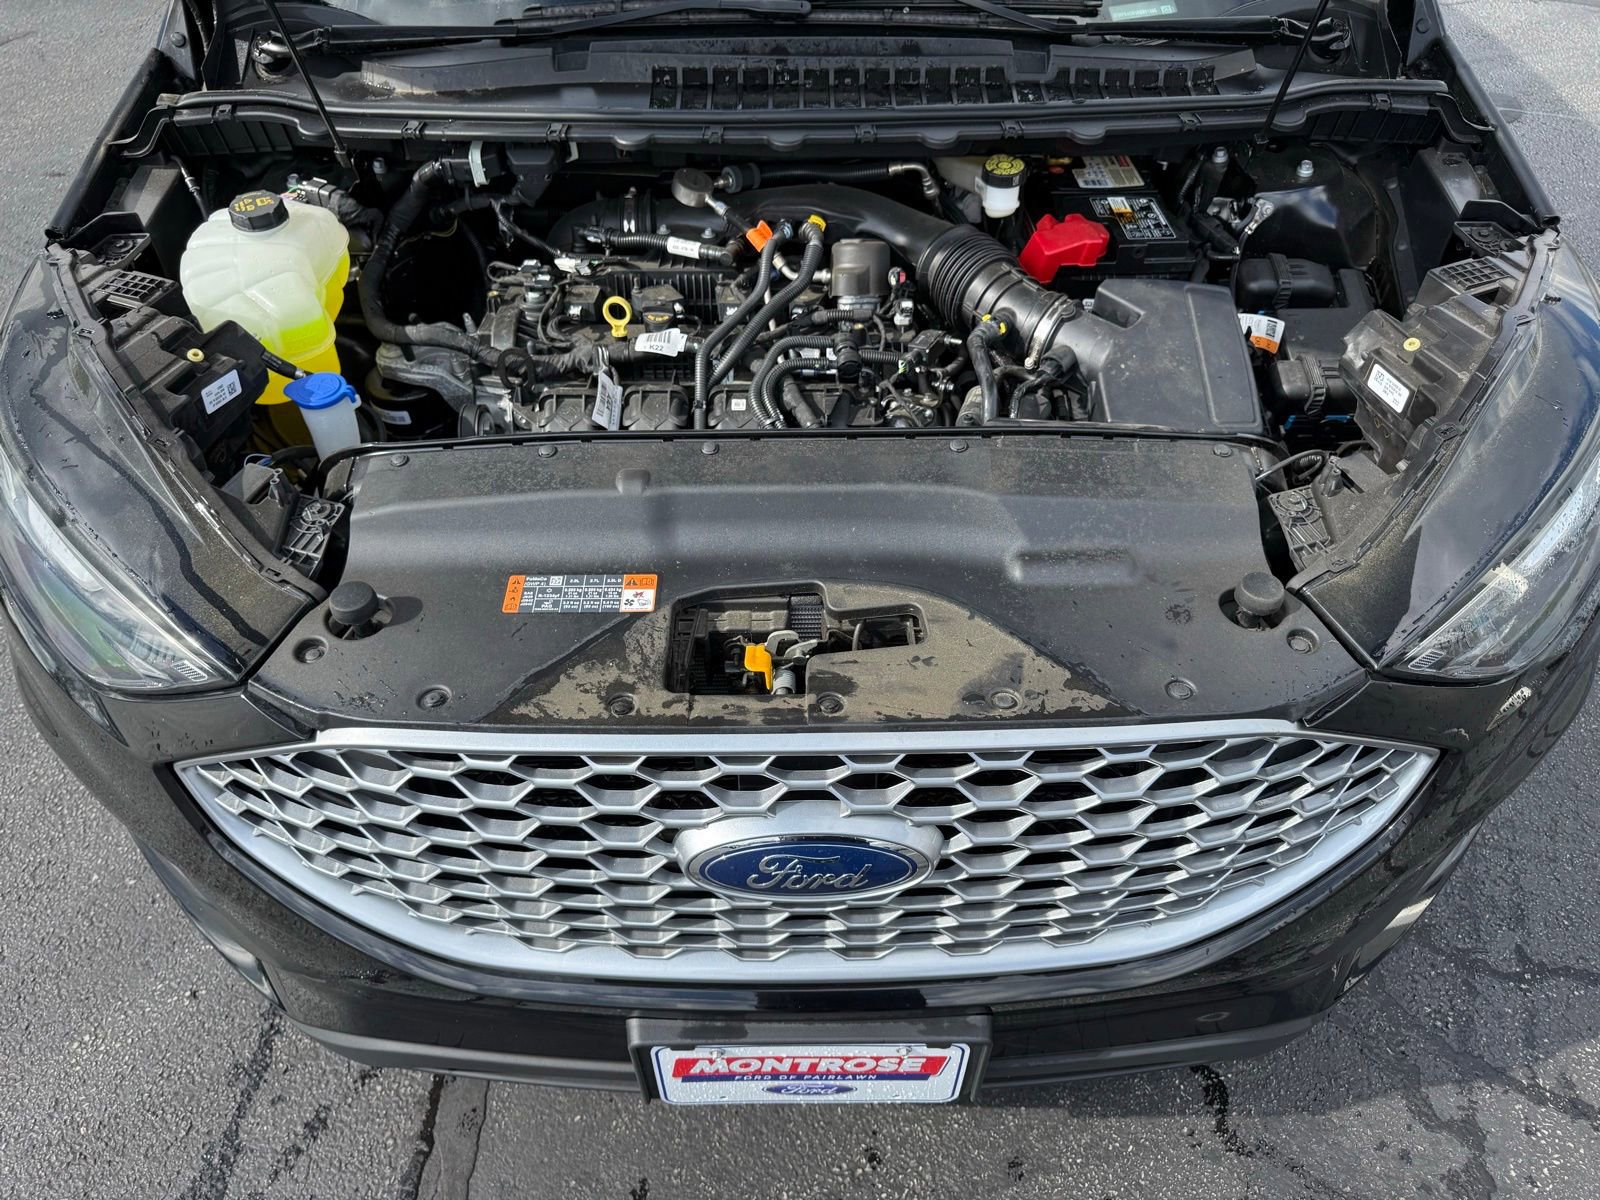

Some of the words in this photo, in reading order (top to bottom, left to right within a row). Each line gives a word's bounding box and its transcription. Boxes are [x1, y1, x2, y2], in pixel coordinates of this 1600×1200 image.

[746, 854, 873, 890] Ford
[690, 1056, 927, 1075] MONTROSE
[781, 1083, 838, 1095] Ford
